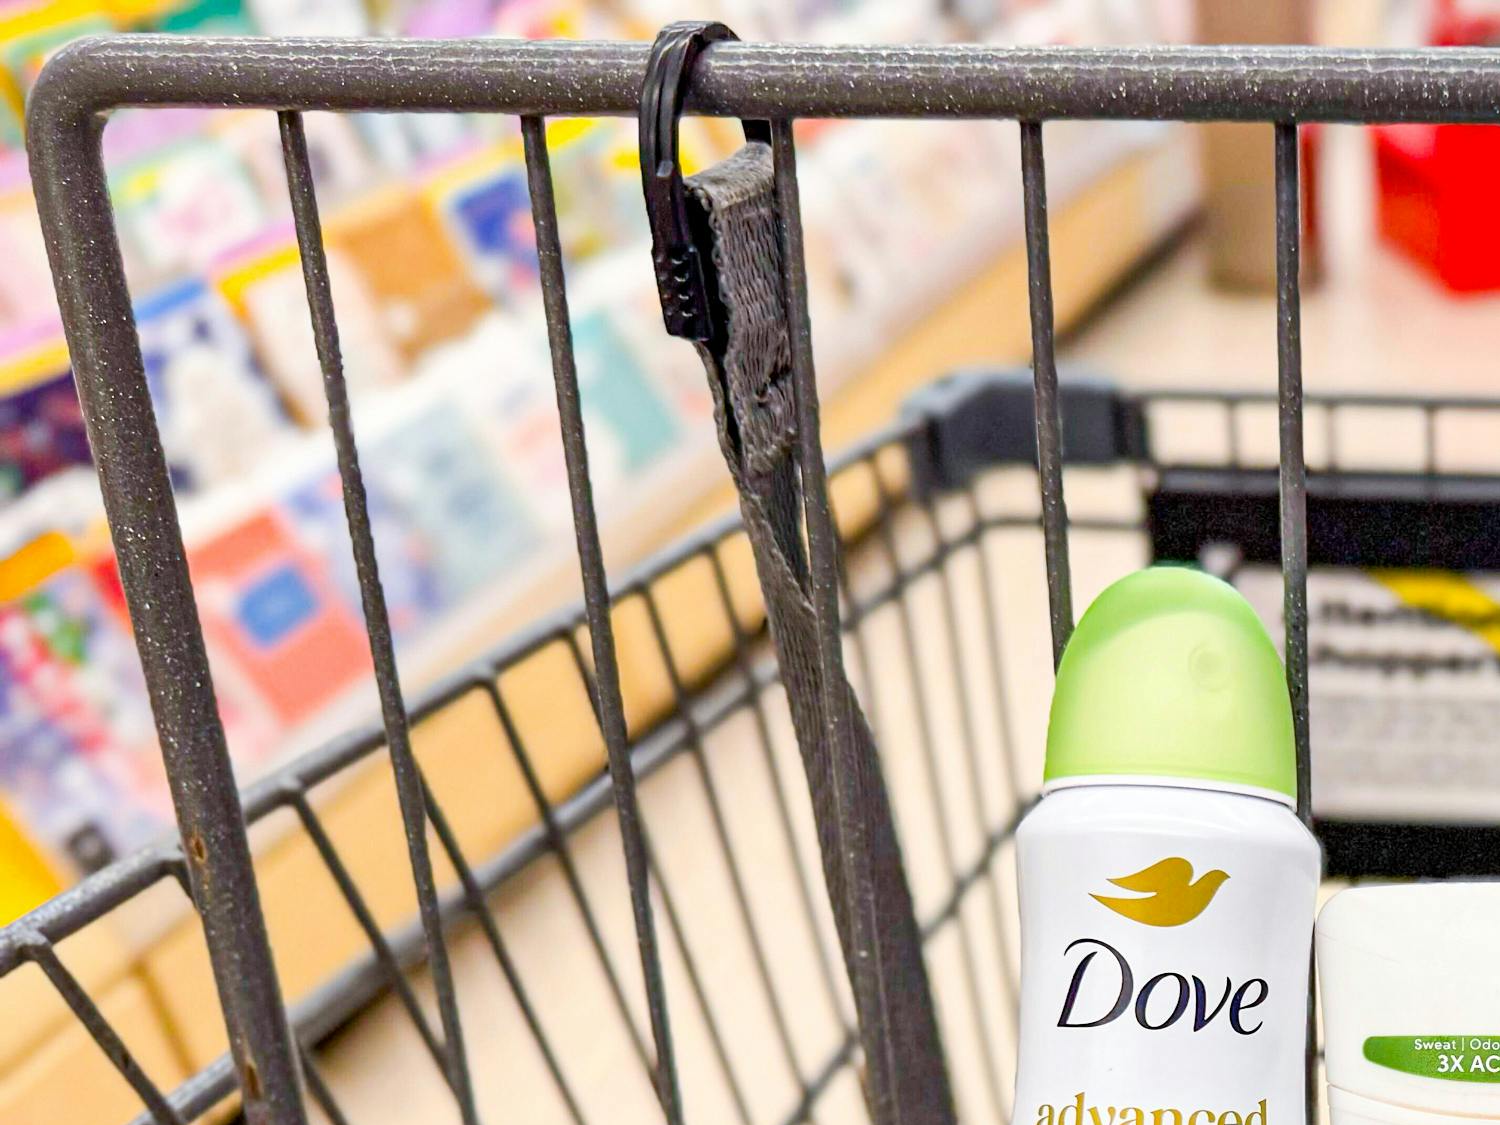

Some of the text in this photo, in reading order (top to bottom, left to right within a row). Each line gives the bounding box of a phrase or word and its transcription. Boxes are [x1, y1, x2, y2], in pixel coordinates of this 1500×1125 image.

[1057, 938, 1269, 1035] Dove
[1414, 1038, 1457, 1051] Sweat
[1437, 1055, 1464, 1073] 3X
